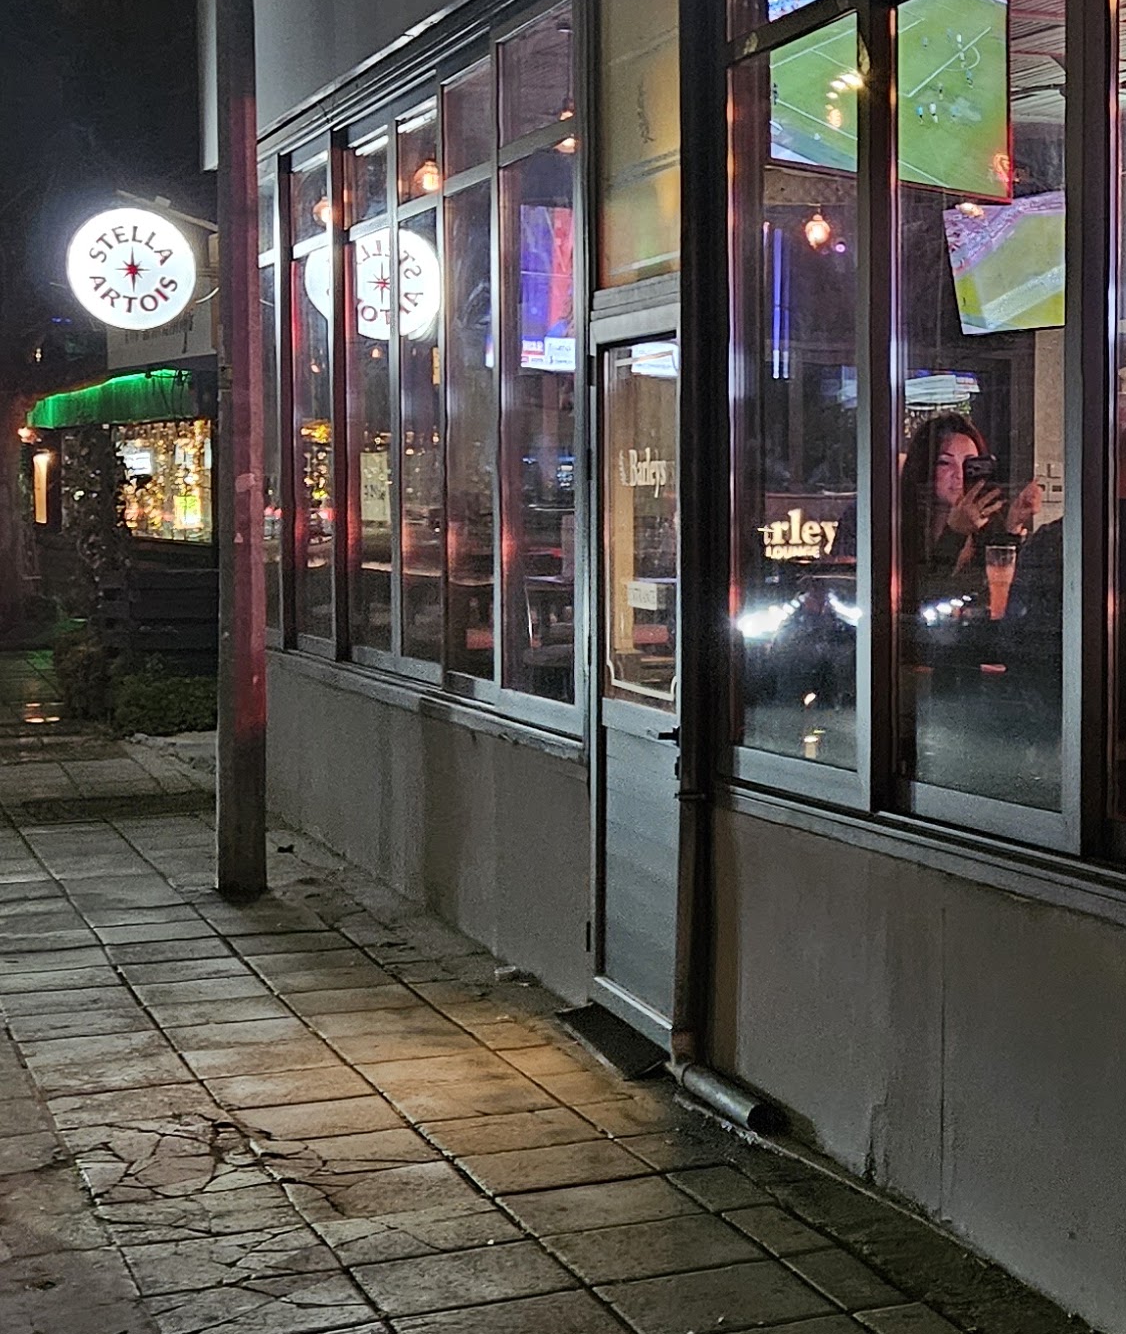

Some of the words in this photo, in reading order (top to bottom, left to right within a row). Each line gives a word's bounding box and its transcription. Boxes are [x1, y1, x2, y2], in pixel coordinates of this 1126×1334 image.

[88, 225, 174, 267] STELLA
[89, 274, 178, 314] ARTOIS
[629, 447, 667, 498] Barleys
[763, 508, 839, 555] rley
